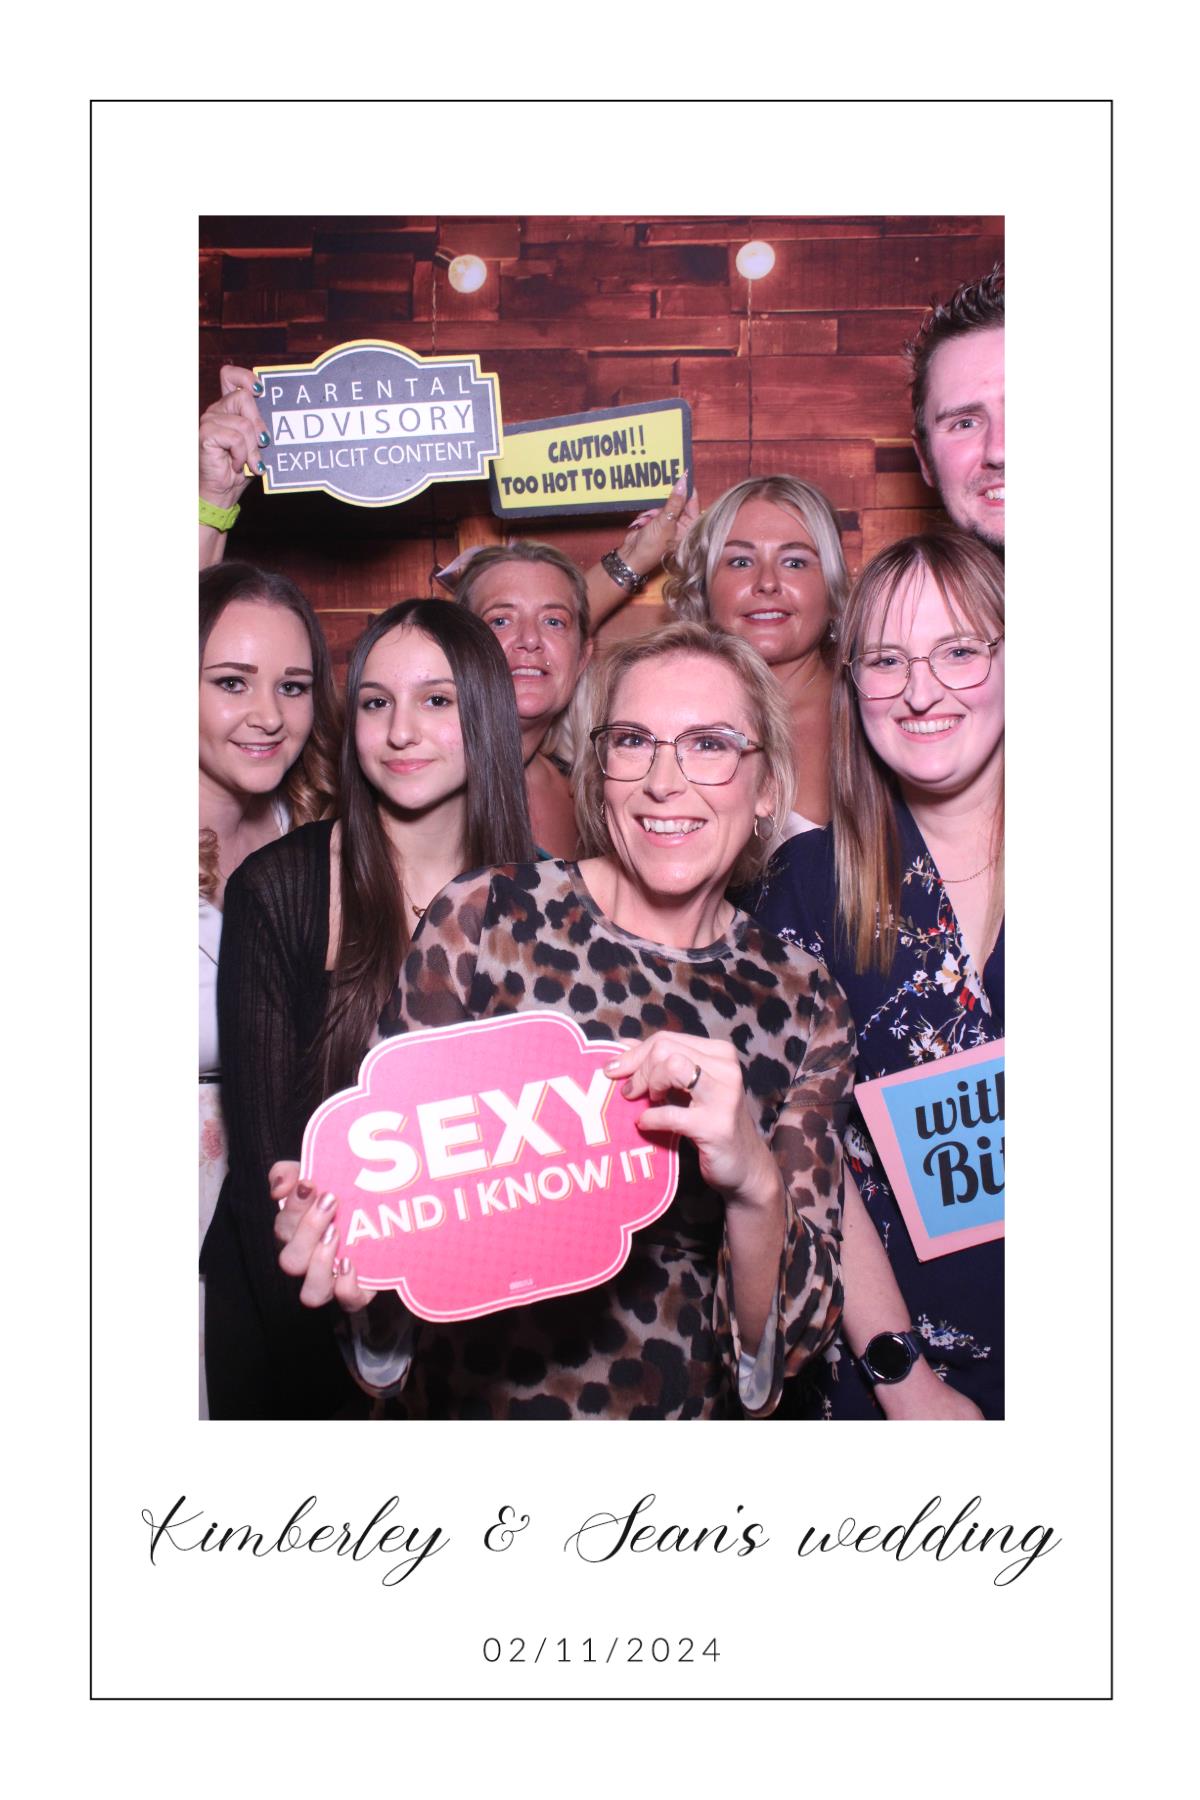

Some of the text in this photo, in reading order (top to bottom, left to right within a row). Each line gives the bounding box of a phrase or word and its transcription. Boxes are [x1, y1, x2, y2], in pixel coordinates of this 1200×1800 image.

[271, 375, 470, 405] PARENTAL
[275, 405, 471, 440] ADVISORY
[277, 440, 475, 472] EXPLICIT CONTENT
[547, 425, 646, 463] CAUTION!!
[501, 458, 680, 496] TOO HOT TO HANDLE
[347, 1068, 617, 1193] SEXY
[923, 1136, 1005, 1207] Bi
[345, 1146, 657, 1247] AND I KNOW IT
